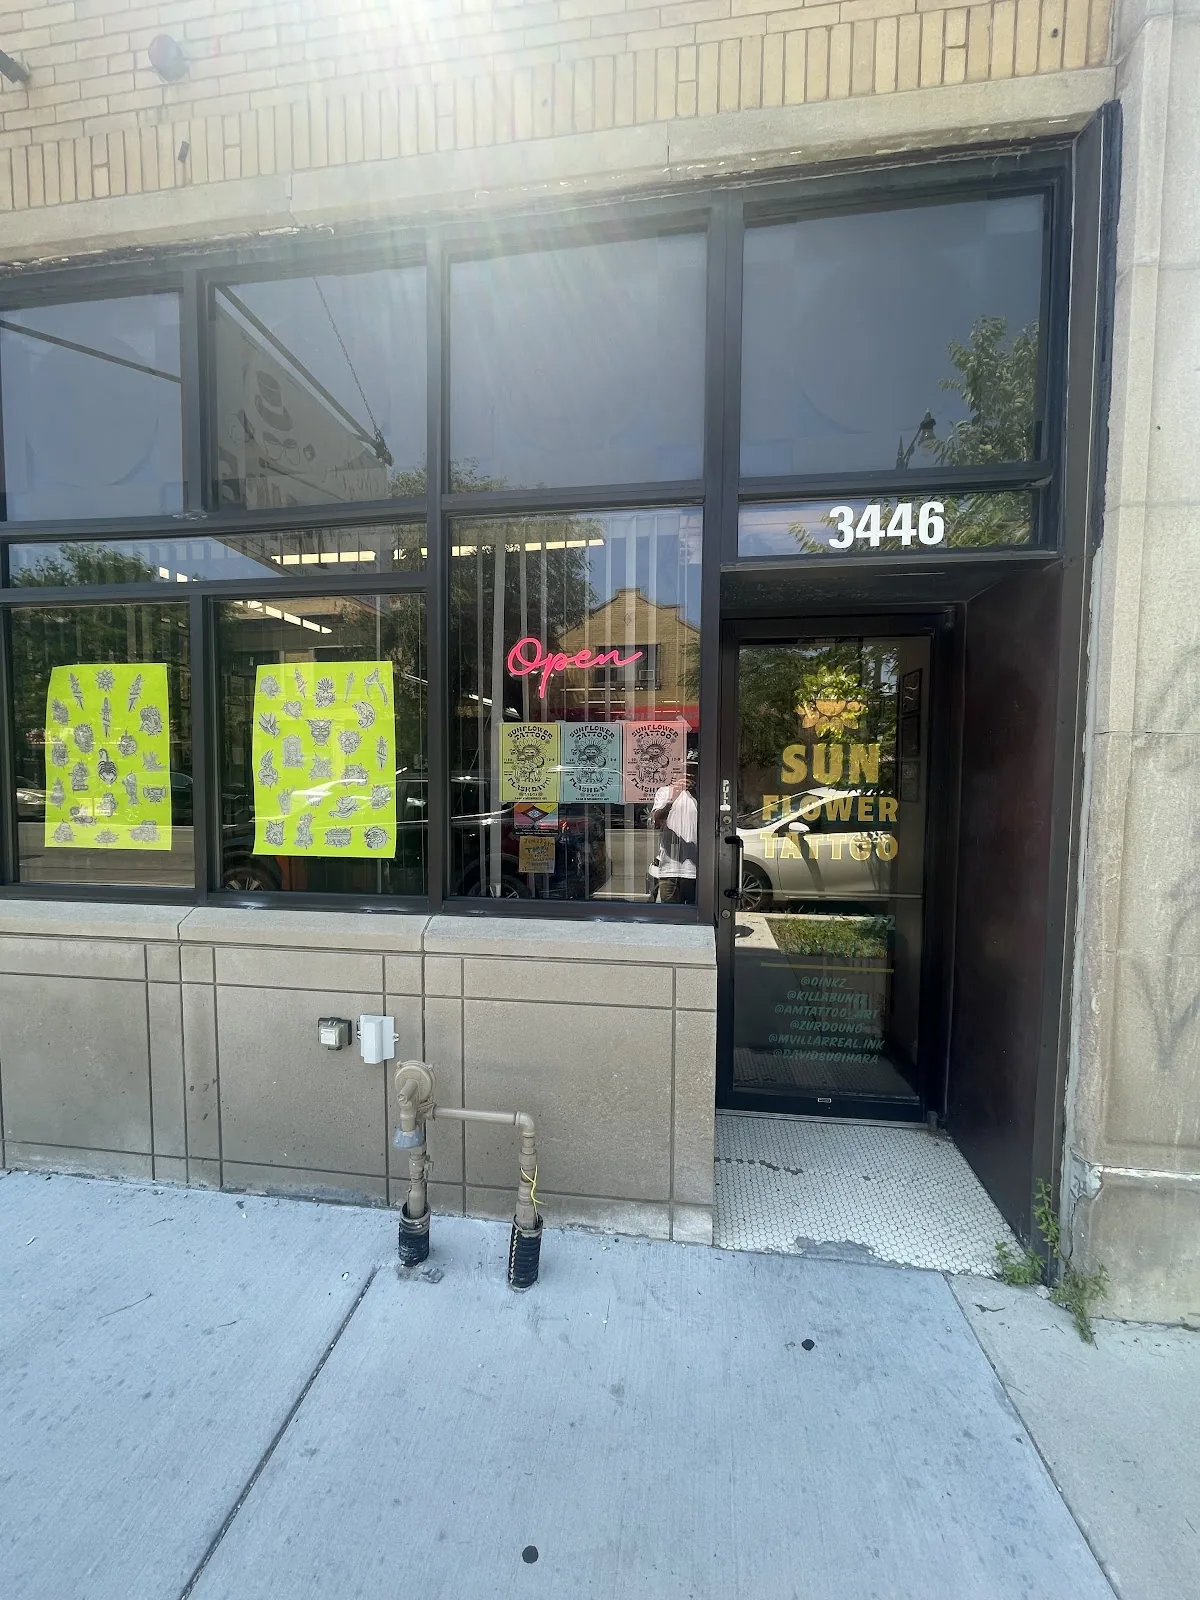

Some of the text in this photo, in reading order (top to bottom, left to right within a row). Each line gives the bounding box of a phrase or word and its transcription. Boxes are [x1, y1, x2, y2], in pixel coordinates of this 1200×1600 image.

[828, 501, 945, 549] 3446
[507, 637, 643, 699] Open
[507, 725, 553, 740] SUNFLOWER
[514, 731, 546, 740] TATTOO
[569, 725, 615, 739] SUNFLOWER
[576, 731, 608, 740] TATTOO
[631, 724, 679, 738] SUNFLOWER
[638, 730, 672, 740] TATTOO
[780, 743, 880, 785] SUN
[762, 795, 899, 822] FLOWER
[760, 832, 899, 861] TATTOO
[790, 1020, 863, 1034] @ZURDOUNO
[768, 1034, 885, 1050] @MVILLARREAL.INK
